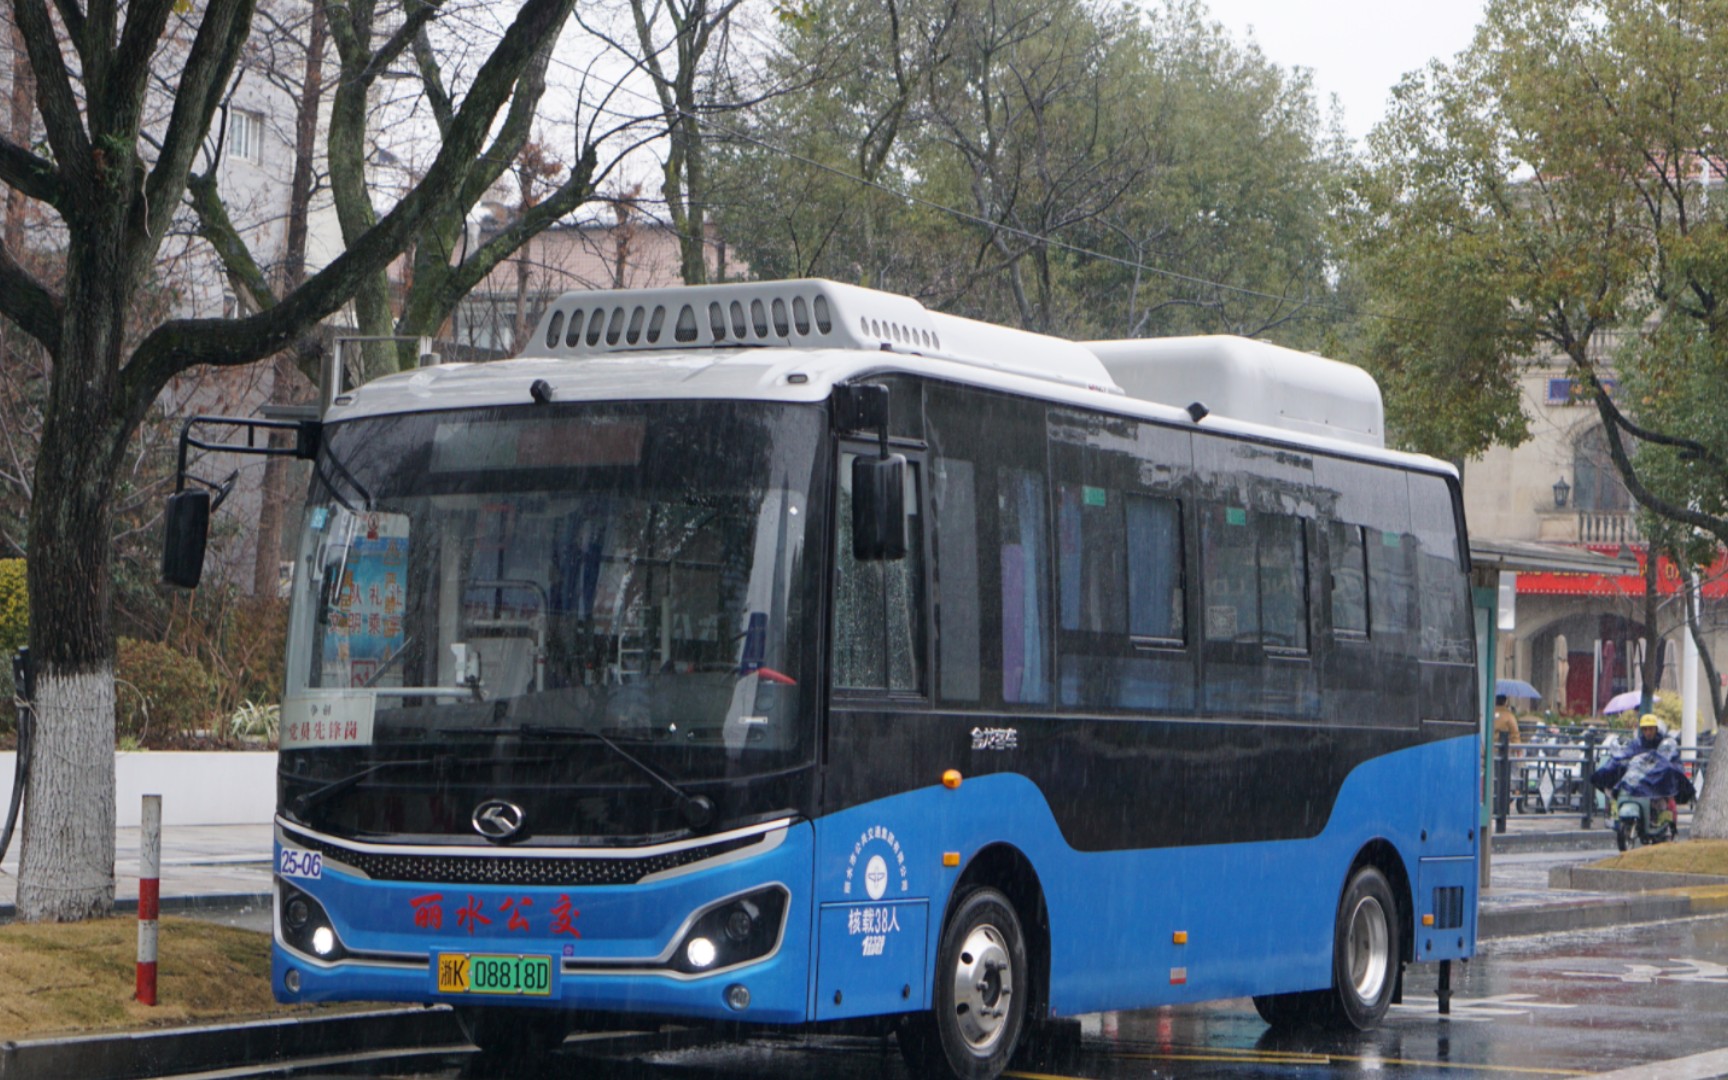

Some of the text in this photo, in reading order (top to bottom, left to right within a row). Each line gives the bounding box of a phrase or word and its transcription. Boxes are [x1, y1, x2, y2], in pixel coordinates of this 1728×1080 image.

[288, 720, 358, 741] 党员先锋岗
[281, 850, 322, 877] 25-06
[409, 893, 582, 940] 丽水公交
[848, 906, 901, 935] 核载38人
[441, 959, 549, 990] 浙K 08818D
